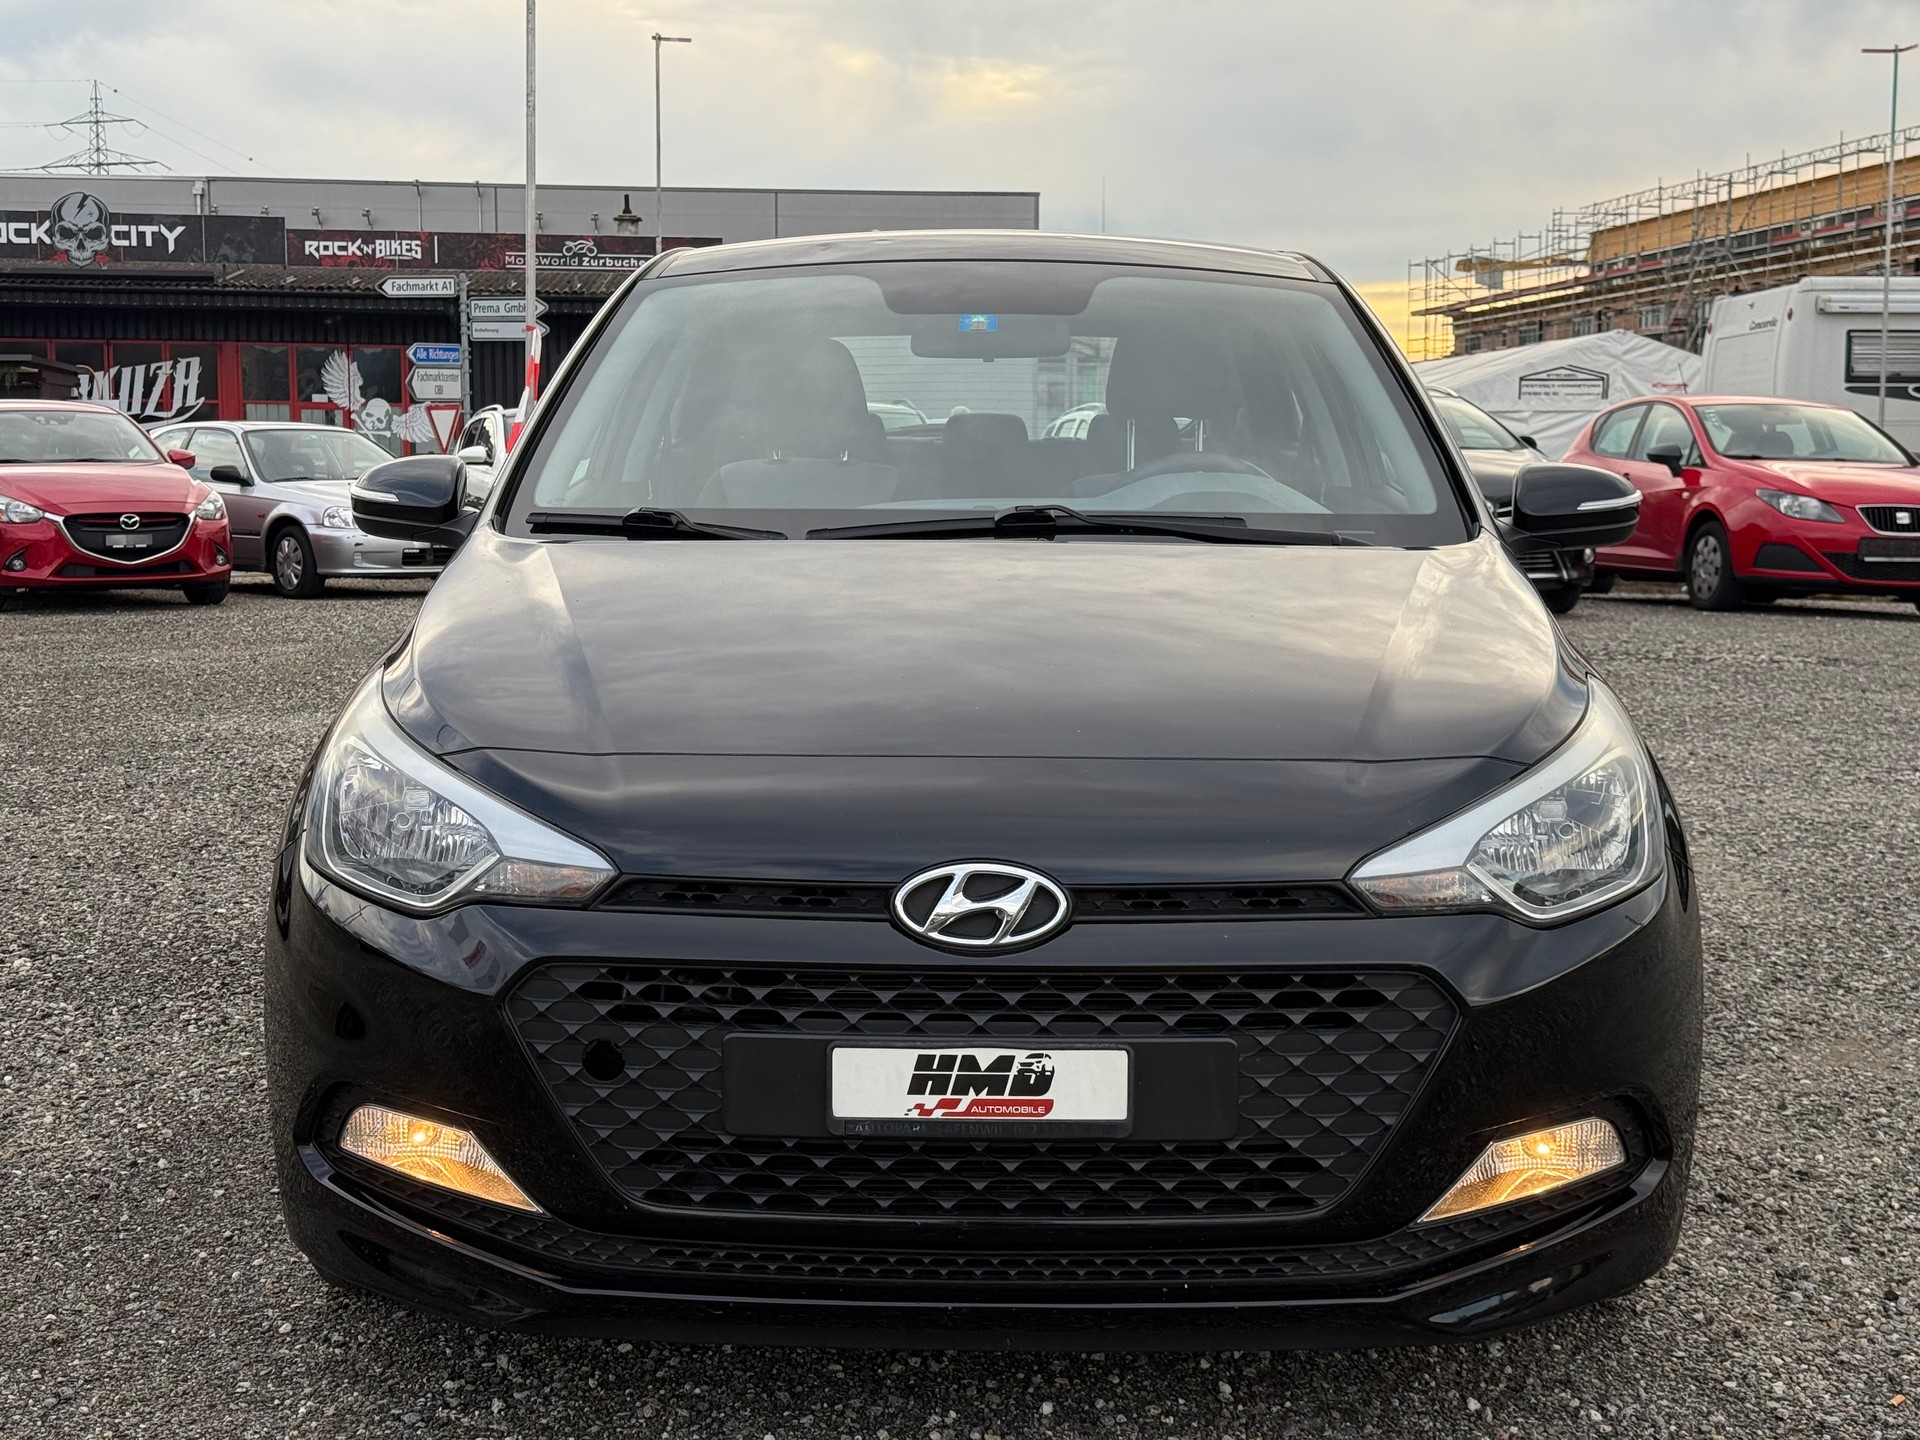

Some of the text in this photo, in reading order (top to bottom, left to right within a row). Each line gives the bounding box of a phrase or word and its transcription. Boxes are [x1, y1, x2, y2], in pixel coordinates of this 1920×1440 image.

[110, 223, 187, 254] CITY
[581, 257, 646, 267] Zurbuche
[391, 280, 452, 292] Fachmarkt A1
[473, 302, 526, 313] Prema Gmb
[416, 348, 459, 362] Alle Richtungen
[416, 371, 460, 382] Fachmarktcenter
[434, 384, 444, 395] OBI
[907, 1053, 1056, 1097] HMD
[970, 1104, 1046, 1115] AUTOMOBILE
